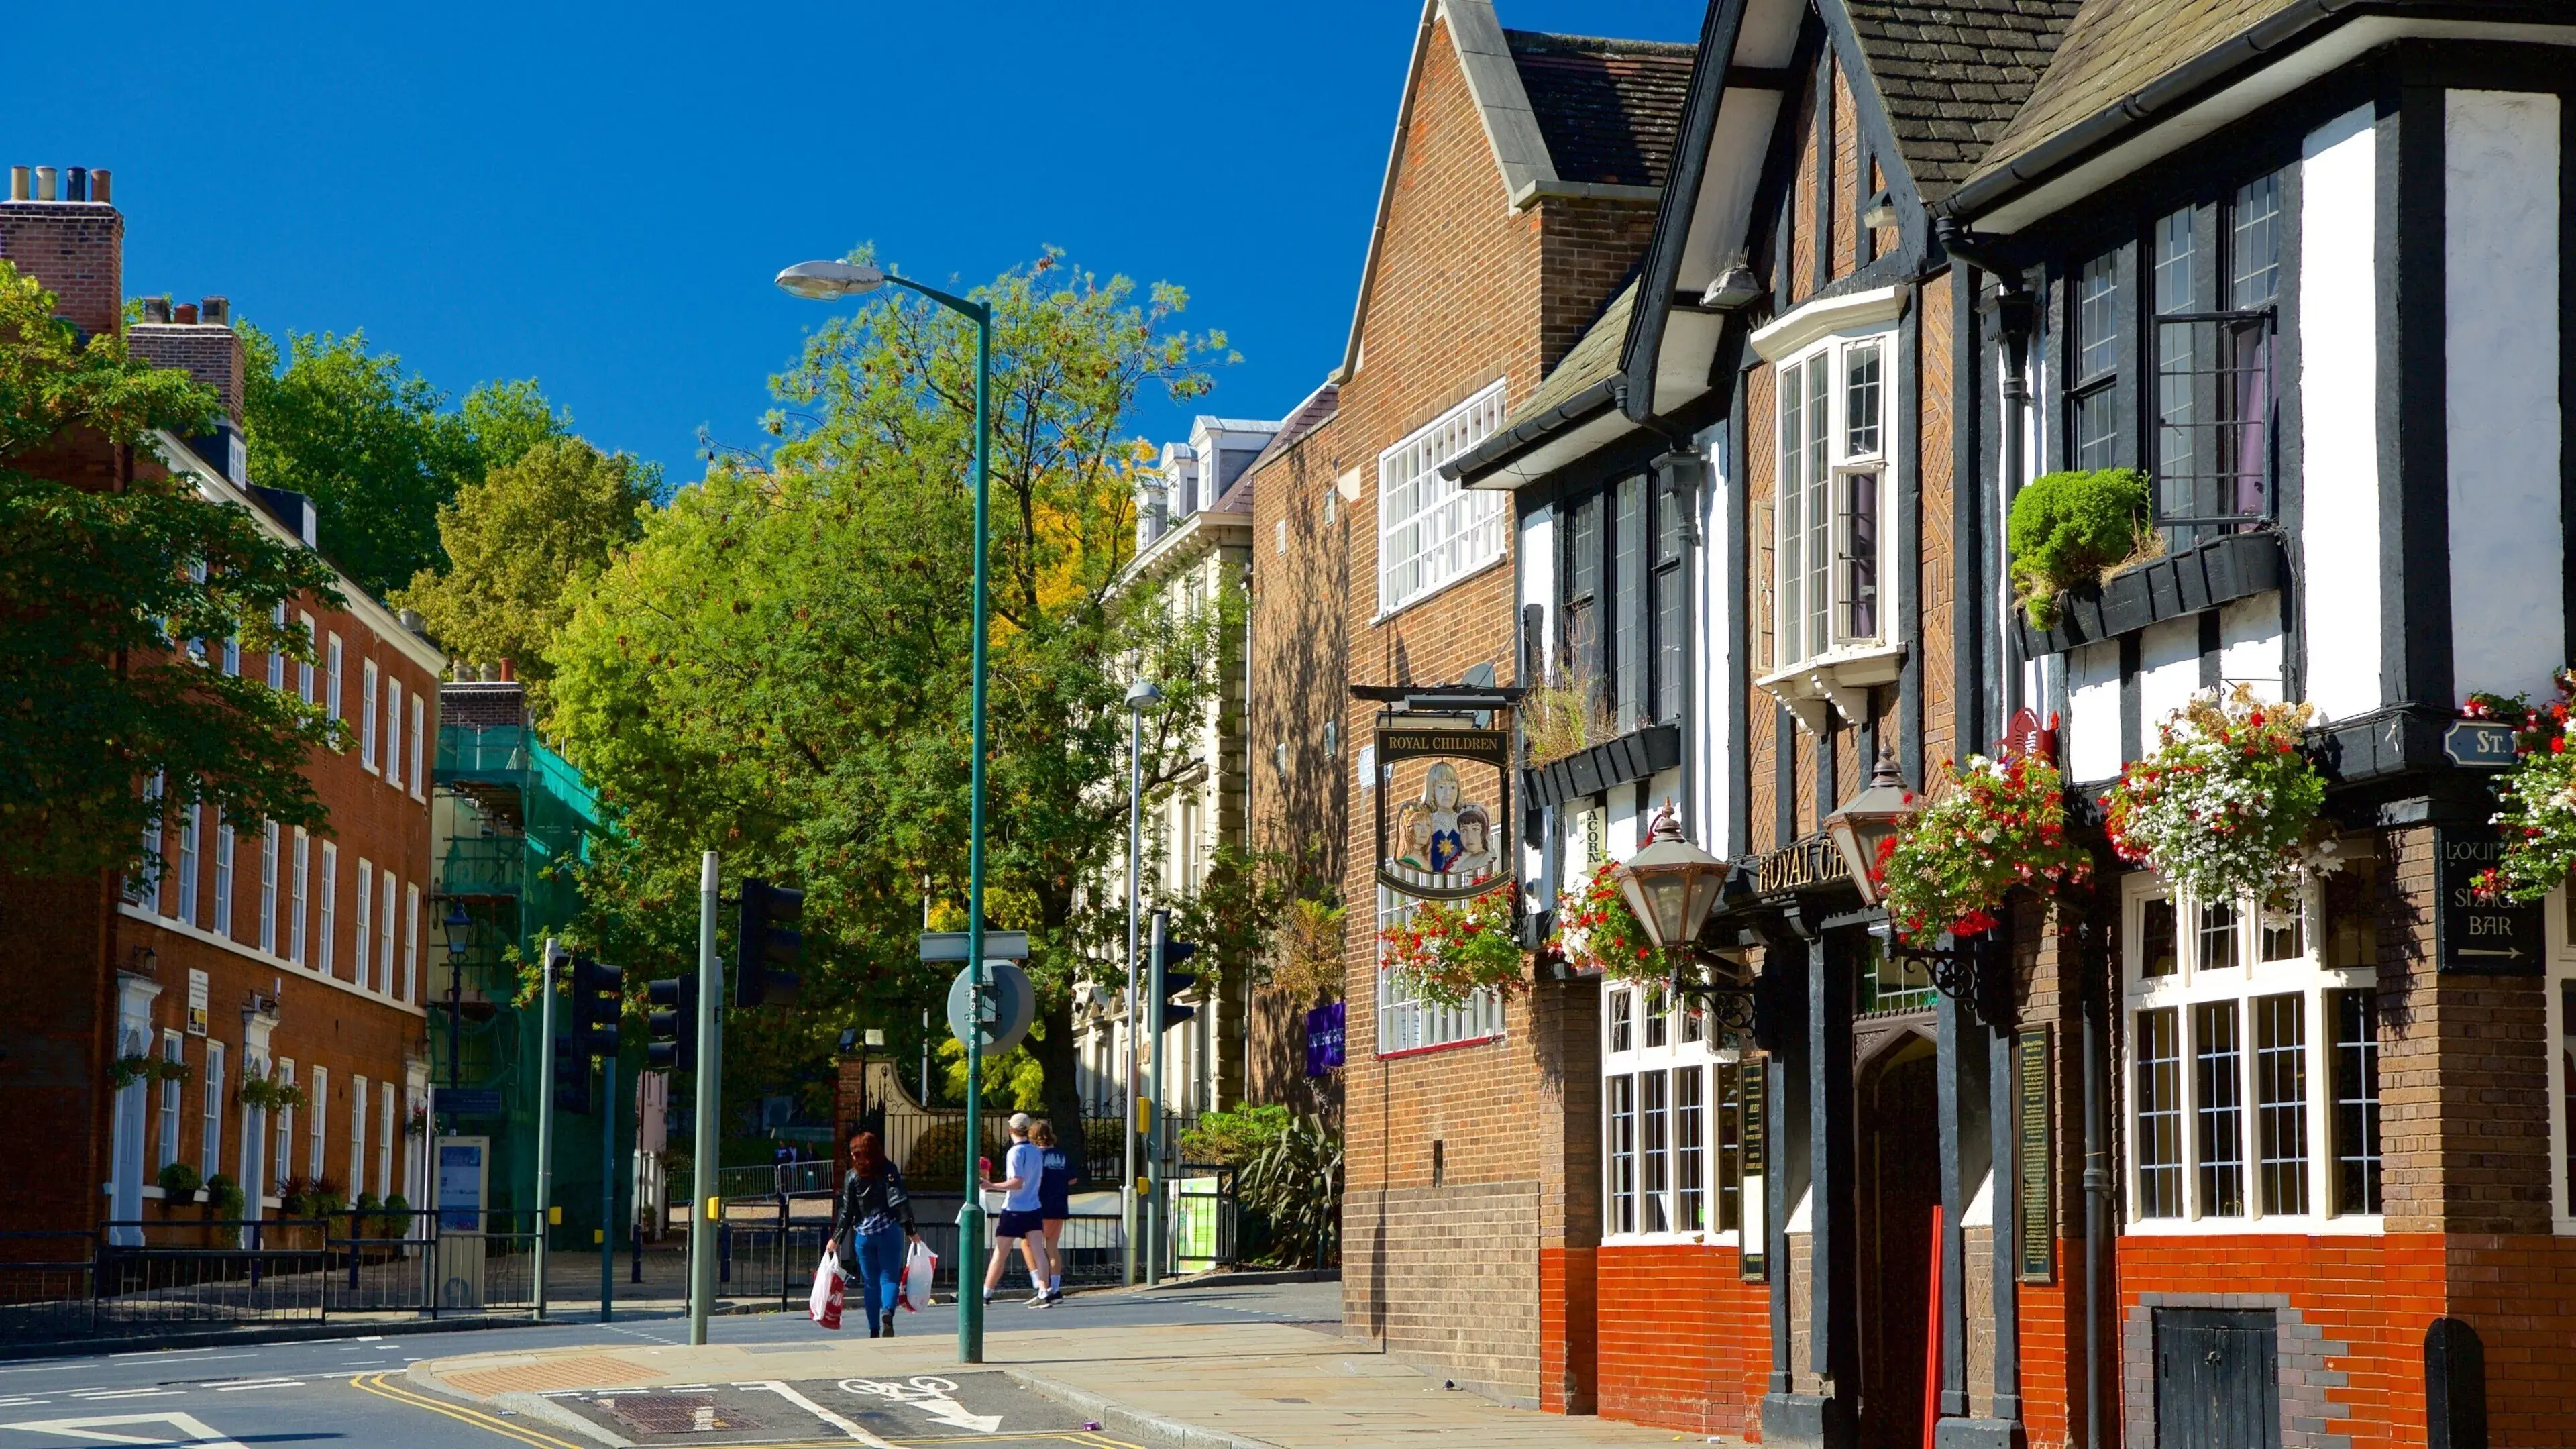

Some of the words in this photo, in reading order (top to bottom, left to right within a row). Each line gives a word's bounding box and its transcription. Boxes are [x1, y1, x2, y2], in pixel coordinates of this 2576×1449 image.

[1389, 736, 1429, 750] ROYAL
[1432, 737, 1498, 751] CHILDREN
[1587, 810, 1599, 863] ACORN
[1758, 843, 1813, 893] ROYAL
[2469, 916, 2513, 936] BAR
